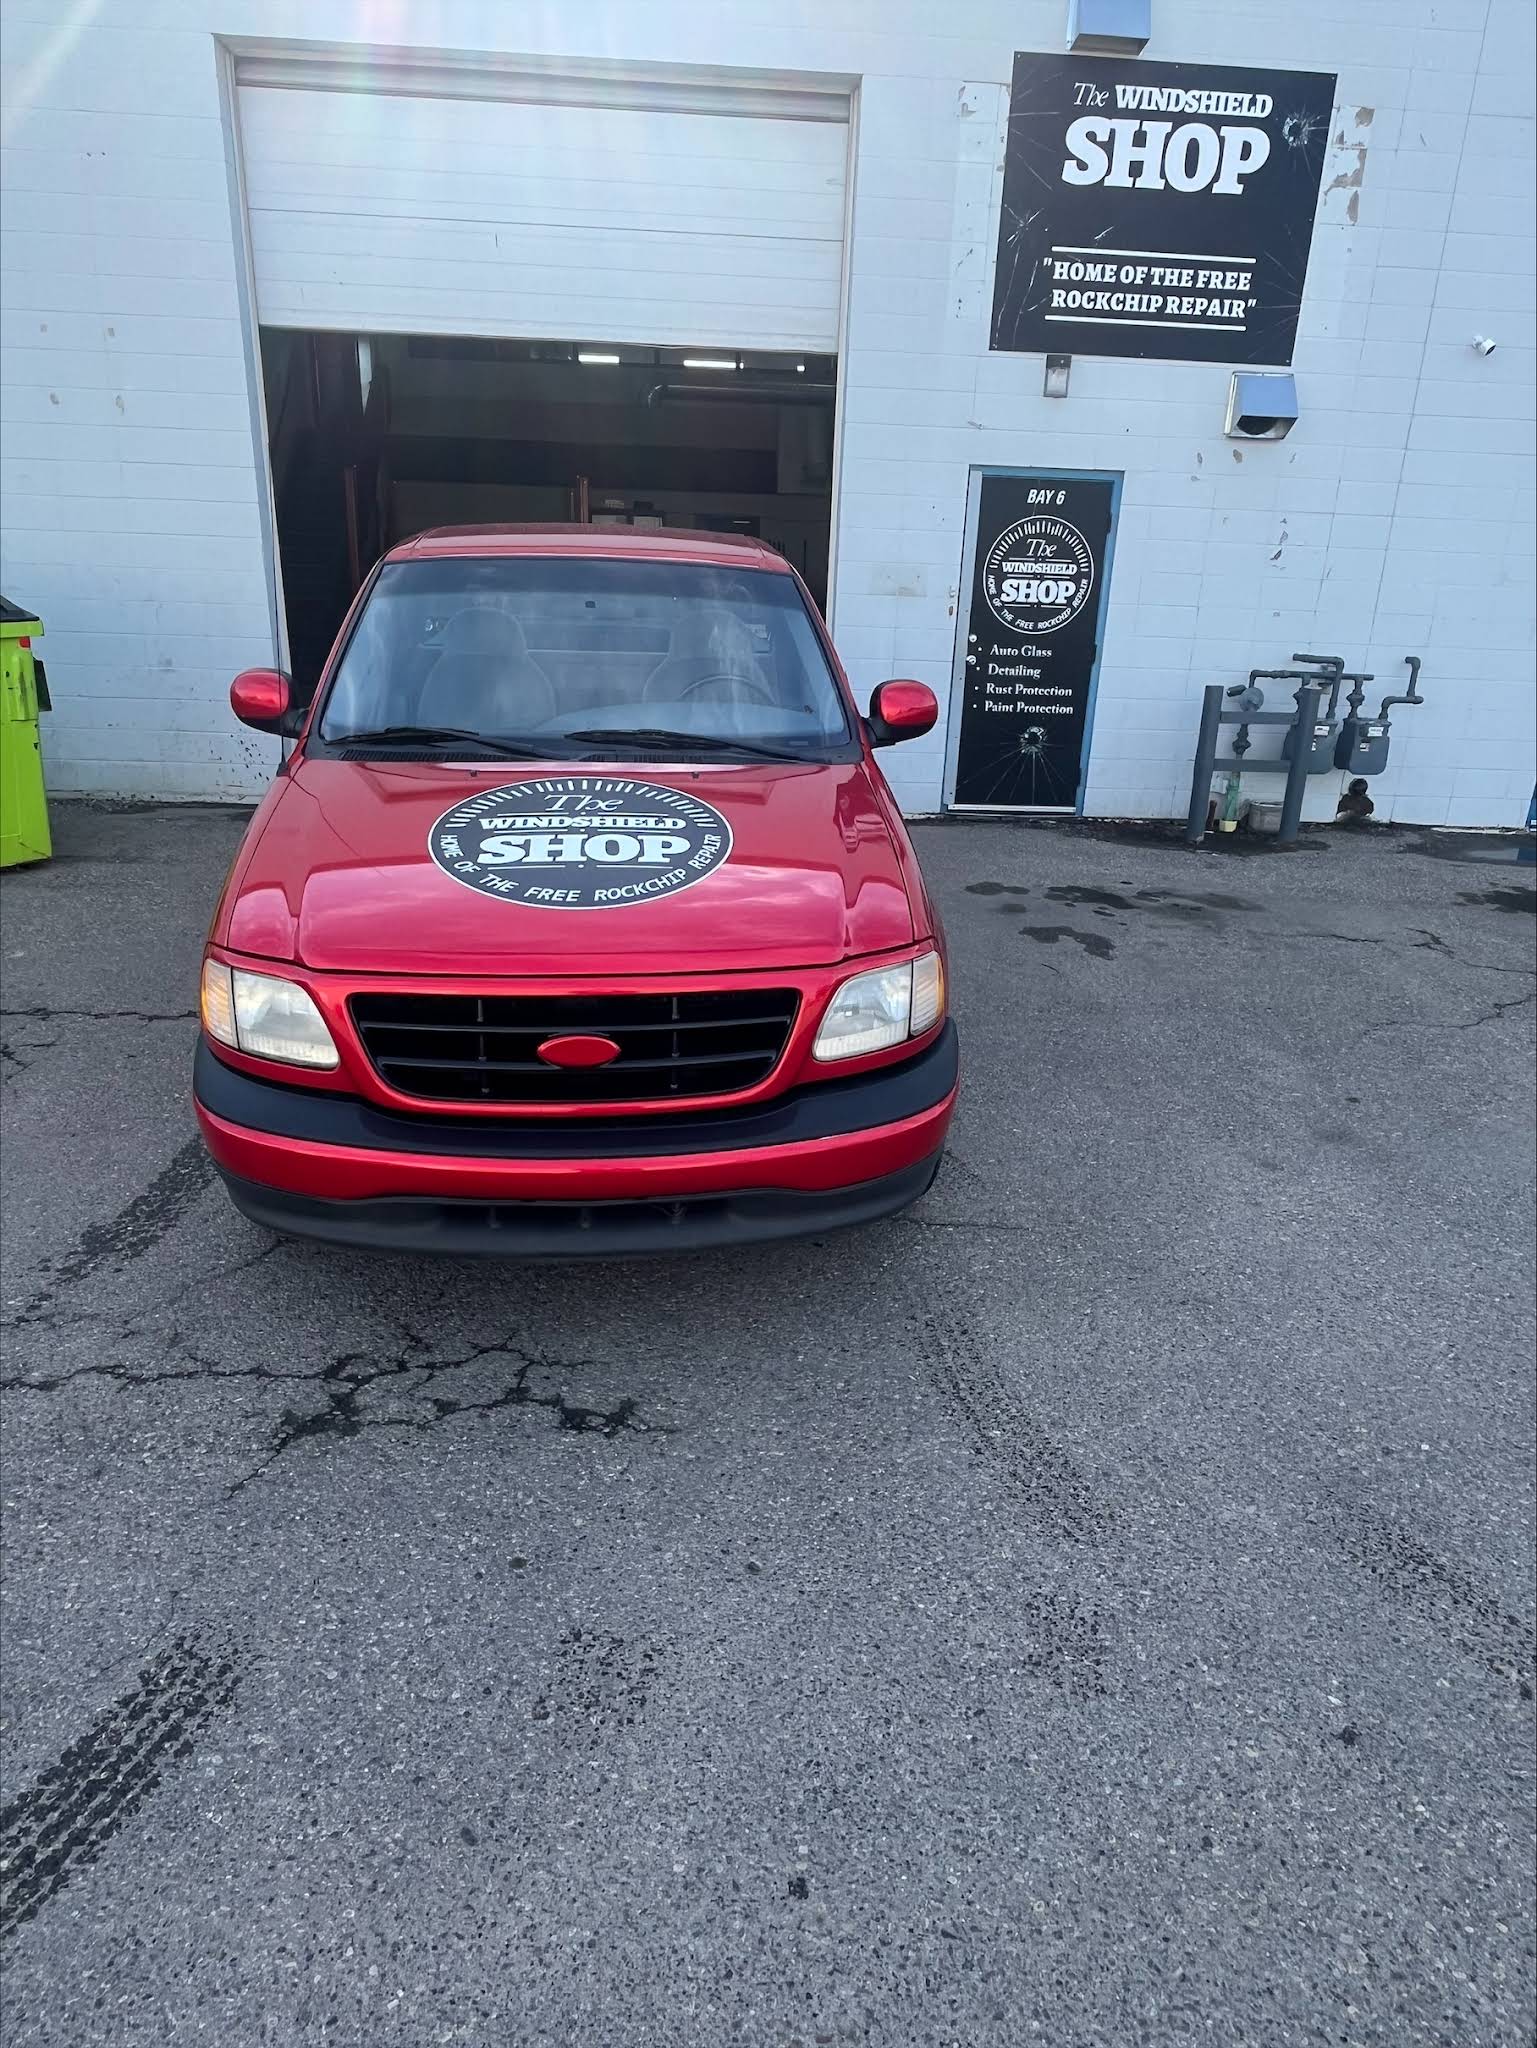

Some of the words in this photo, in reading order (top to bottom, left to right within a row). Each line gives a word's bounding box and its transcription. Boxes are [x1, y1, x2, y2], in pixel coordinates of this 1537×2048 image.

[1073, 82, 1109, 108] The
[1115, 84, 1274, 118] WINDSHIELD
[1061, 115, 1271, 195] SHOP
[1120, 266, 1149, 285] OF
[1150, 266, 1196, 288] THE
[1197, 271, 1253, 292] FREE
[1050, 289, 1163, 314] ROCKCHIP
[1027, 489, 1054, 505] BAY
[1056, 490, 1066, 505] 6
[1026, 538, 1057, 557] The
[1002, 561, 1078, 576] WINDSHIELD
[1000, 579, 1077, 604] SHOP
[992, 597, 1003, 608] OF
[1001, 608, 1015, 622] THE
[1015, 618, 1035, 630] FREE
[1037, 607, 1072, 630] ROCKCHIP
[1072, 578, 1089, 608] REPAIR
[990, 644, 1018, 656] Auto
[1021, 645, 1052, 657] Glass
[988, 663, 1042, 679] Detailing
[986, 682, 1012, 695] Rust
[1014, 683, 1073, 697] Protection
[984, 700, 1013, 713] Paint
[1016, 702, 1074, 715] Protection
[543, 794, 625, 812] The
[479, 816, 687, 830] WINDSHIELD
[476, 833, 692, 864] SHOP
[440, 834, 464, 859] HOME
[453, 860, 482, 874] OF
[479, 873, 519, 893] THE
[523, 886, 582, 902] FREE
[594, 868, 687, 902] ROCKCHIP
[687, 833, 722, 871] REPAIR
